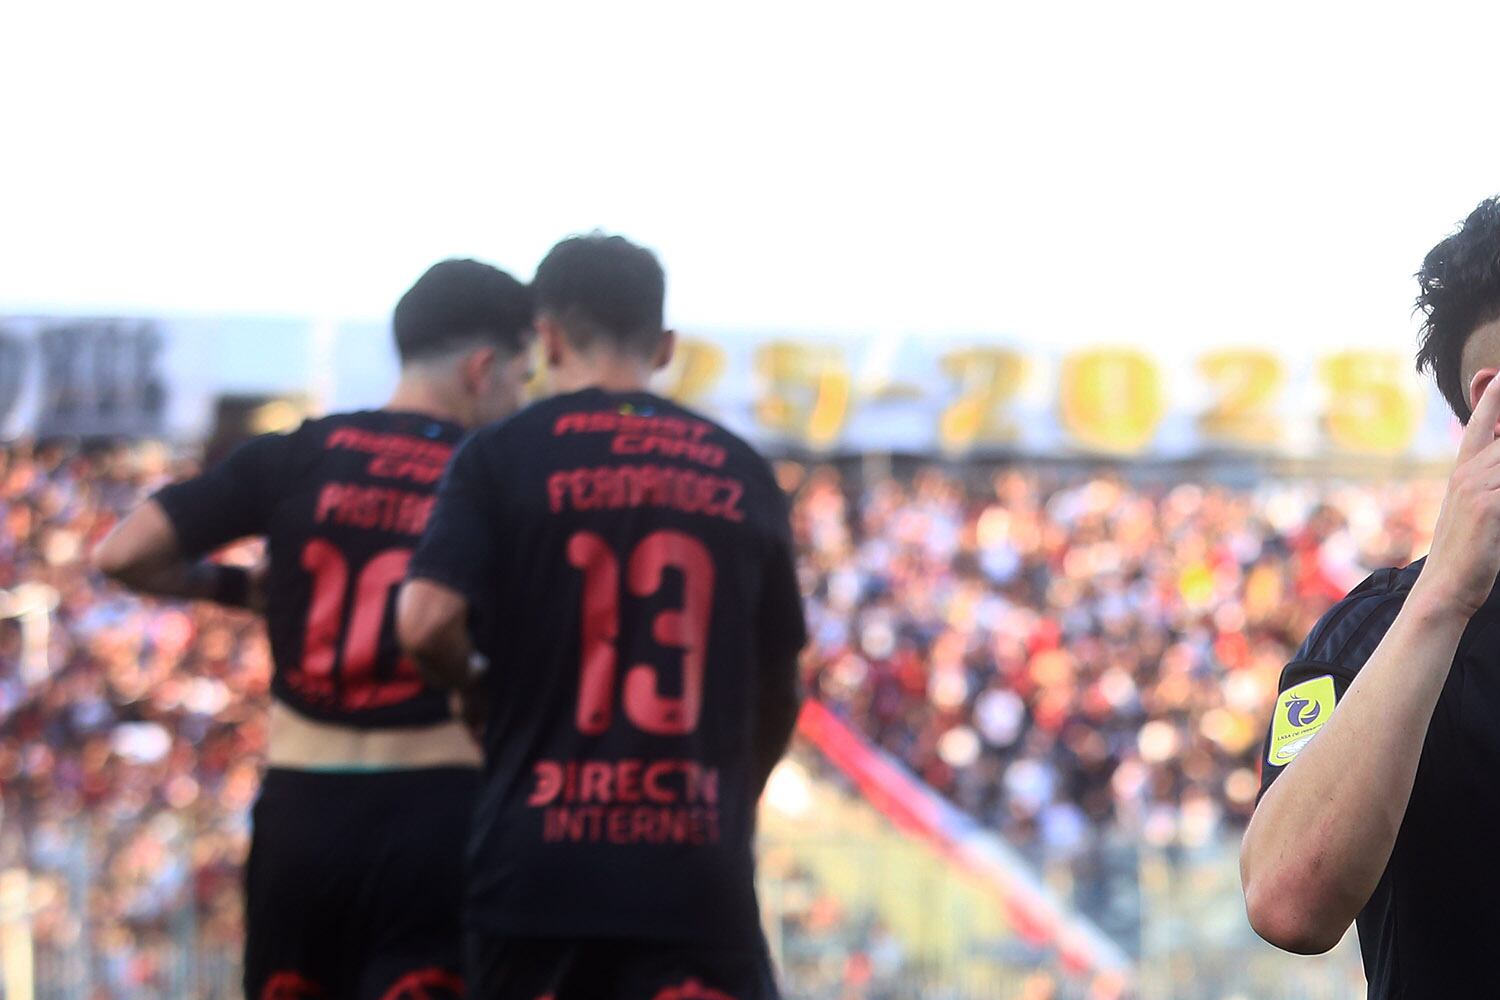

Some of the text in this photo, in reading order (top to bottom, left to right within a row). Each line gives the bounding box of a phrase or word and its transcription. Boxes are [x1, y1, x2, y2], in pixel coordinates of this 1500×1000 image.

[547, 464, 745, 523] FERNANDEZ
[566, 529, 717, 736] 13
[543, 804, 720, 844] INTERNET
